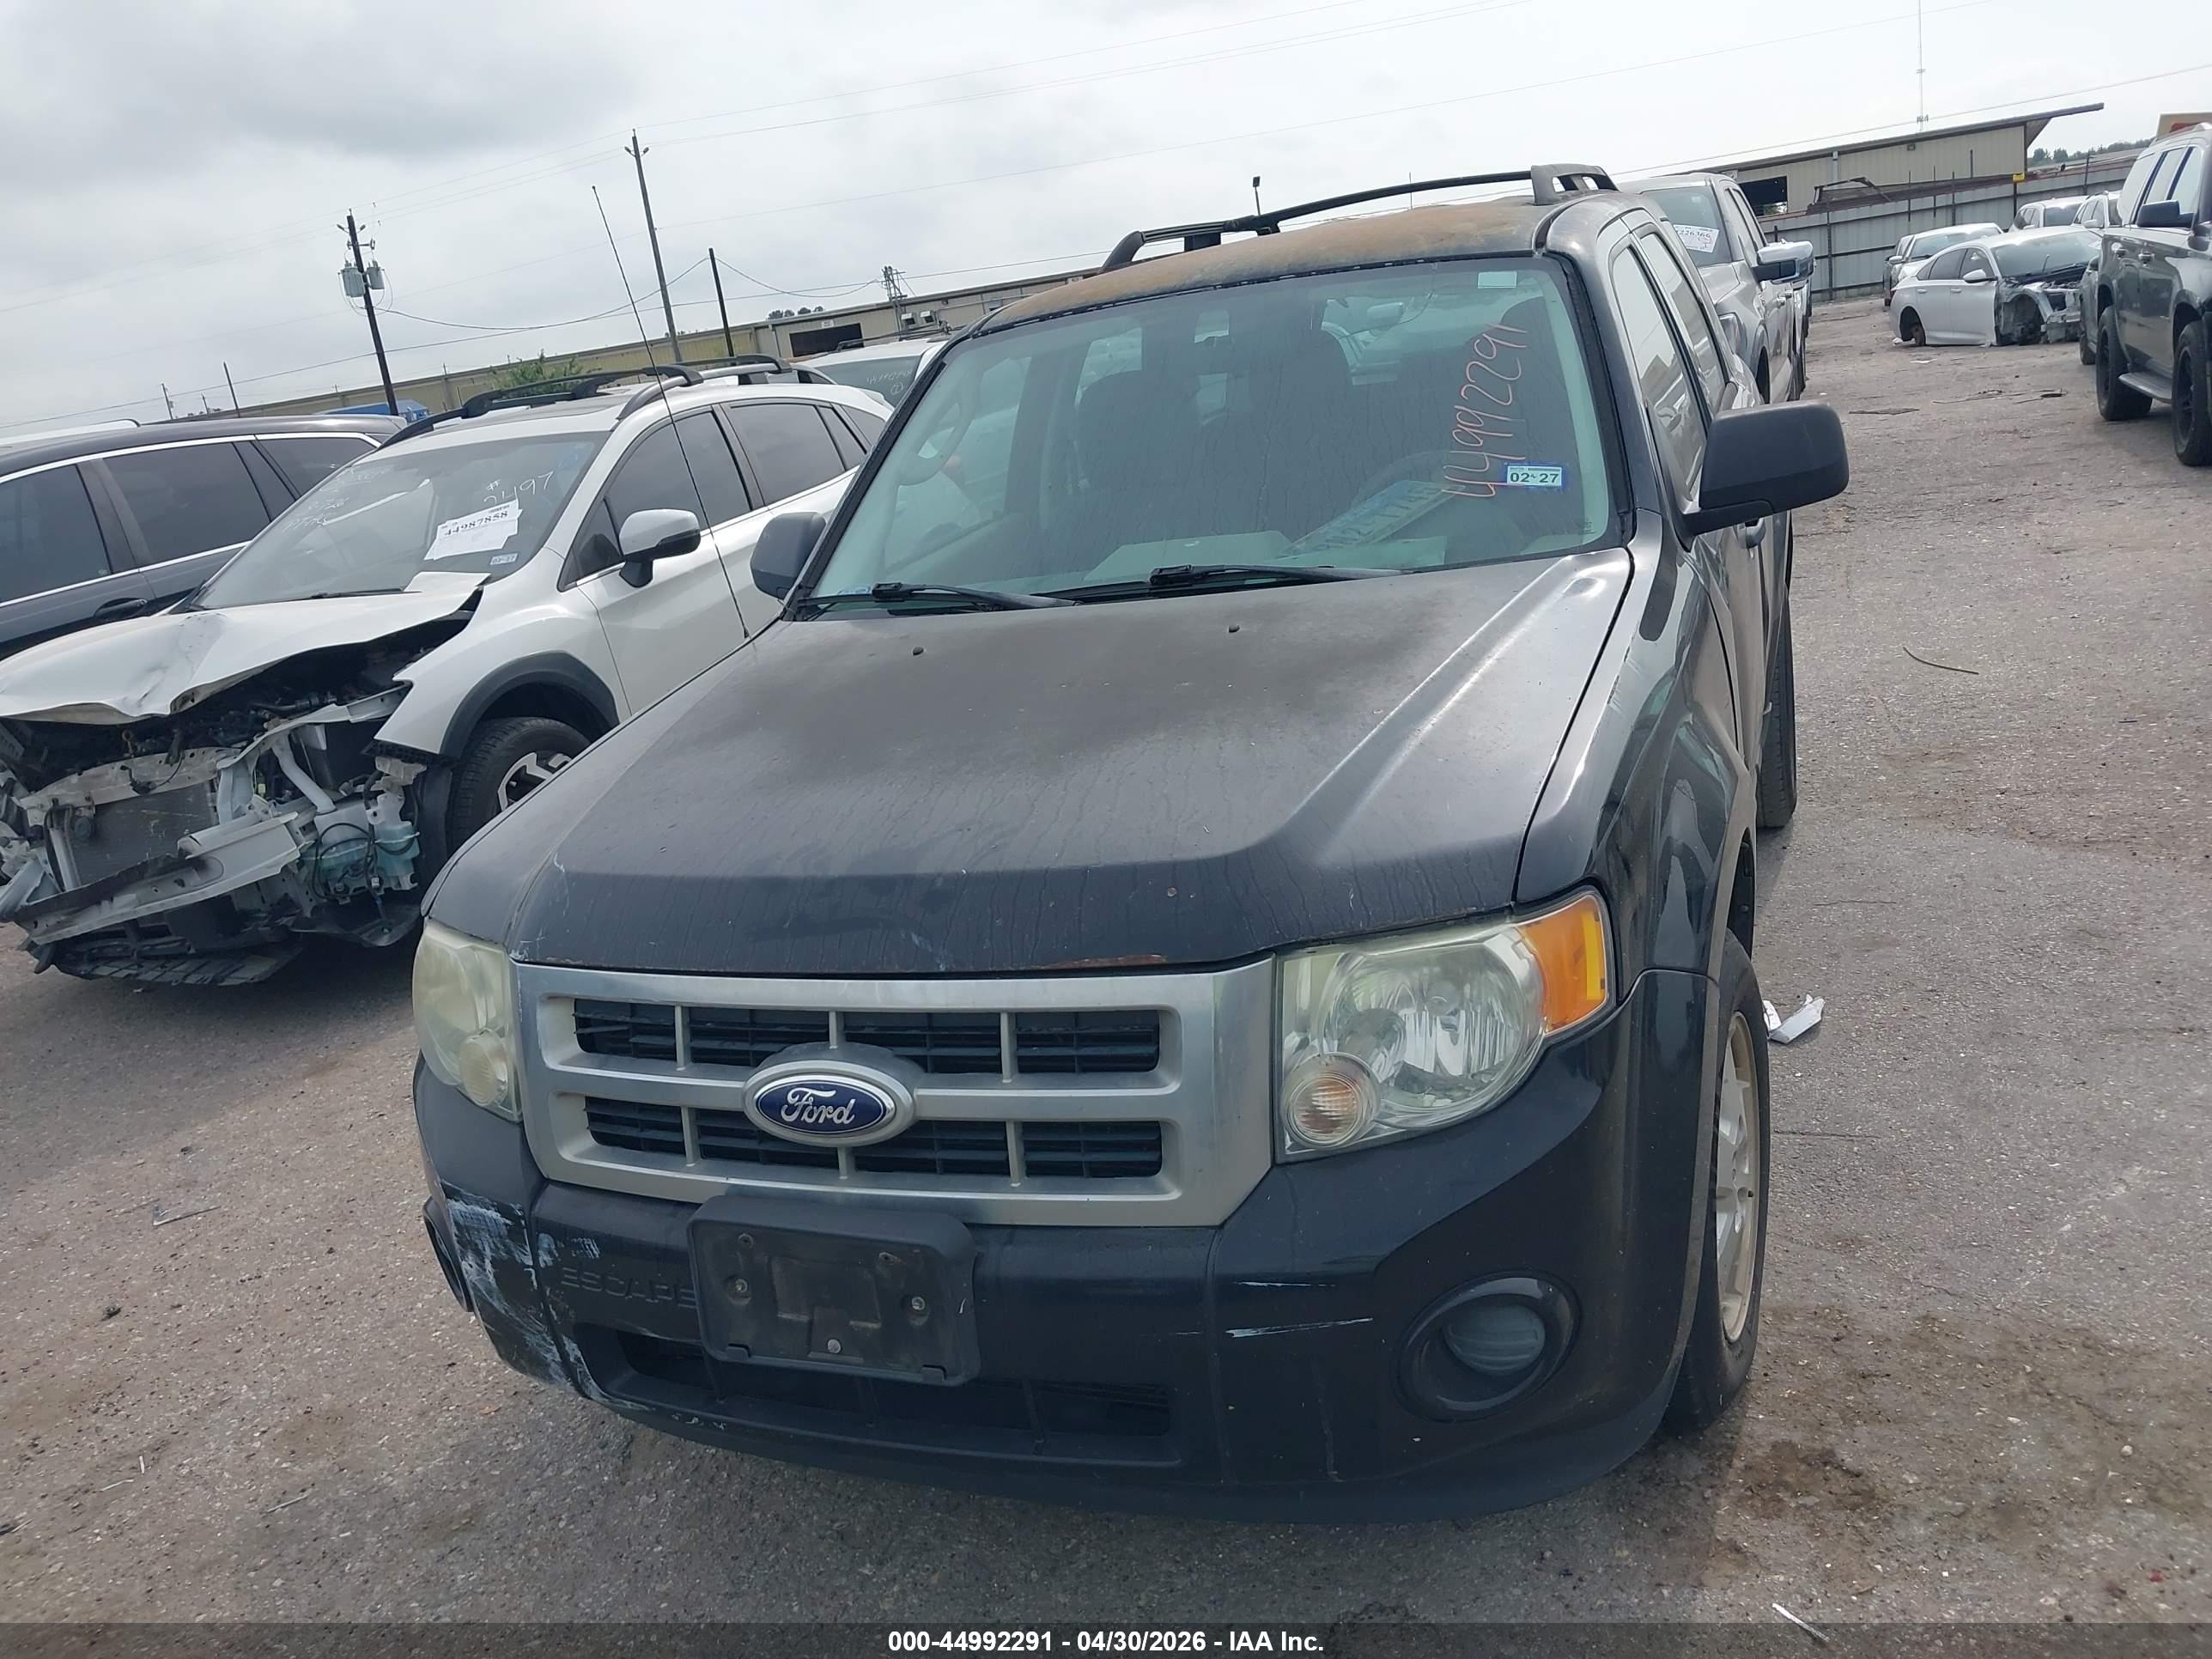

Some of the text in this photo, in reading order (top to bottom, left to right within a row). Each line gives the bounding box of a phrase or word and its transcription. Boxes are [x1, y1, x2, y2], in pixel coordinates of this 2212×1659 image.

[1442, 324, 1528, 498] 44992291
[1510, 472, 1559, 483] 02 27
[781, 1087, 857, 1125] Ford
[561, 1267, 698, 1310] ESCAPE
